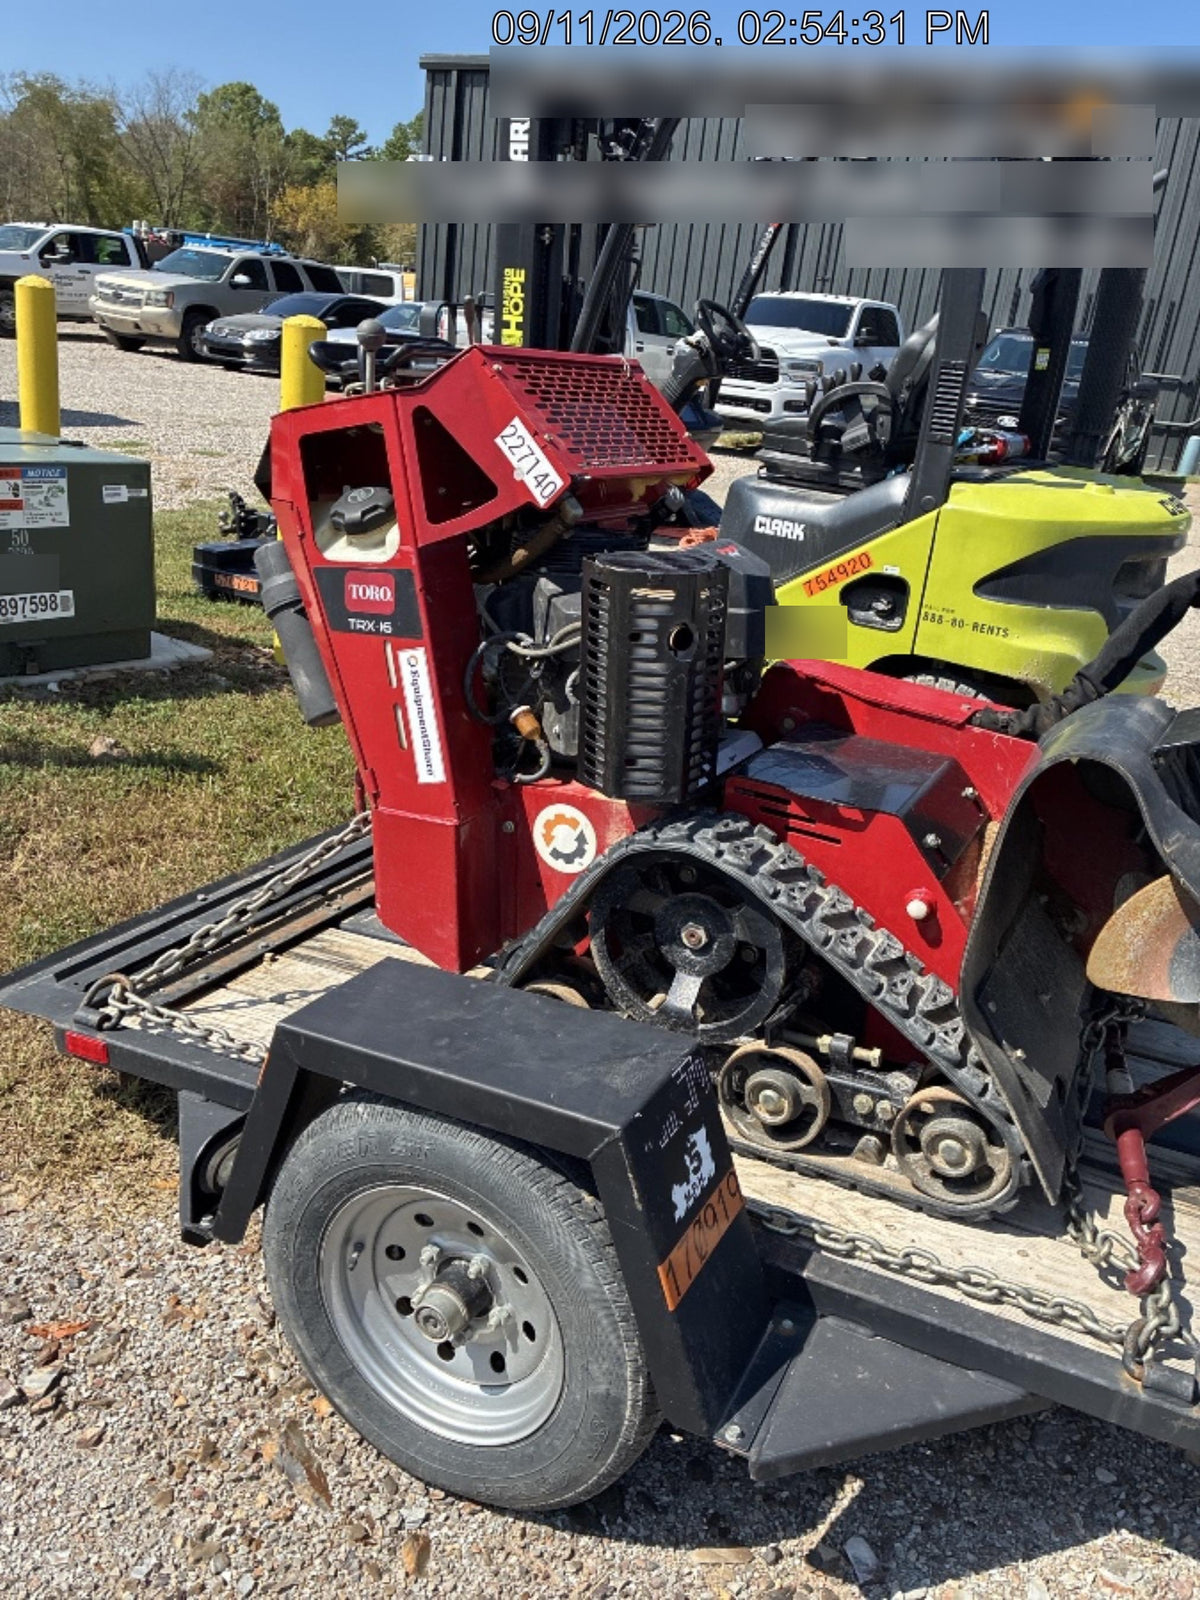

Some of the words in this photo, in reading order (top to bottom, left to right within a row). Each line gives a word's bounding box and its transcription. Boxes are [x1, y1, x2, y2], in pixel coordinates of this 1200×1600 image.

[501, 267, 526, 337] HOPE
[26, 468, 61, 477] NOTICE
[500, 424, 557, 500] 227140
[754, 515, 806, 541] CLARK
[348, 584, 392, 602] TORO
[802, 551, 872, 597] 754920
[410, 669, 433, 776] EquipmentShare
